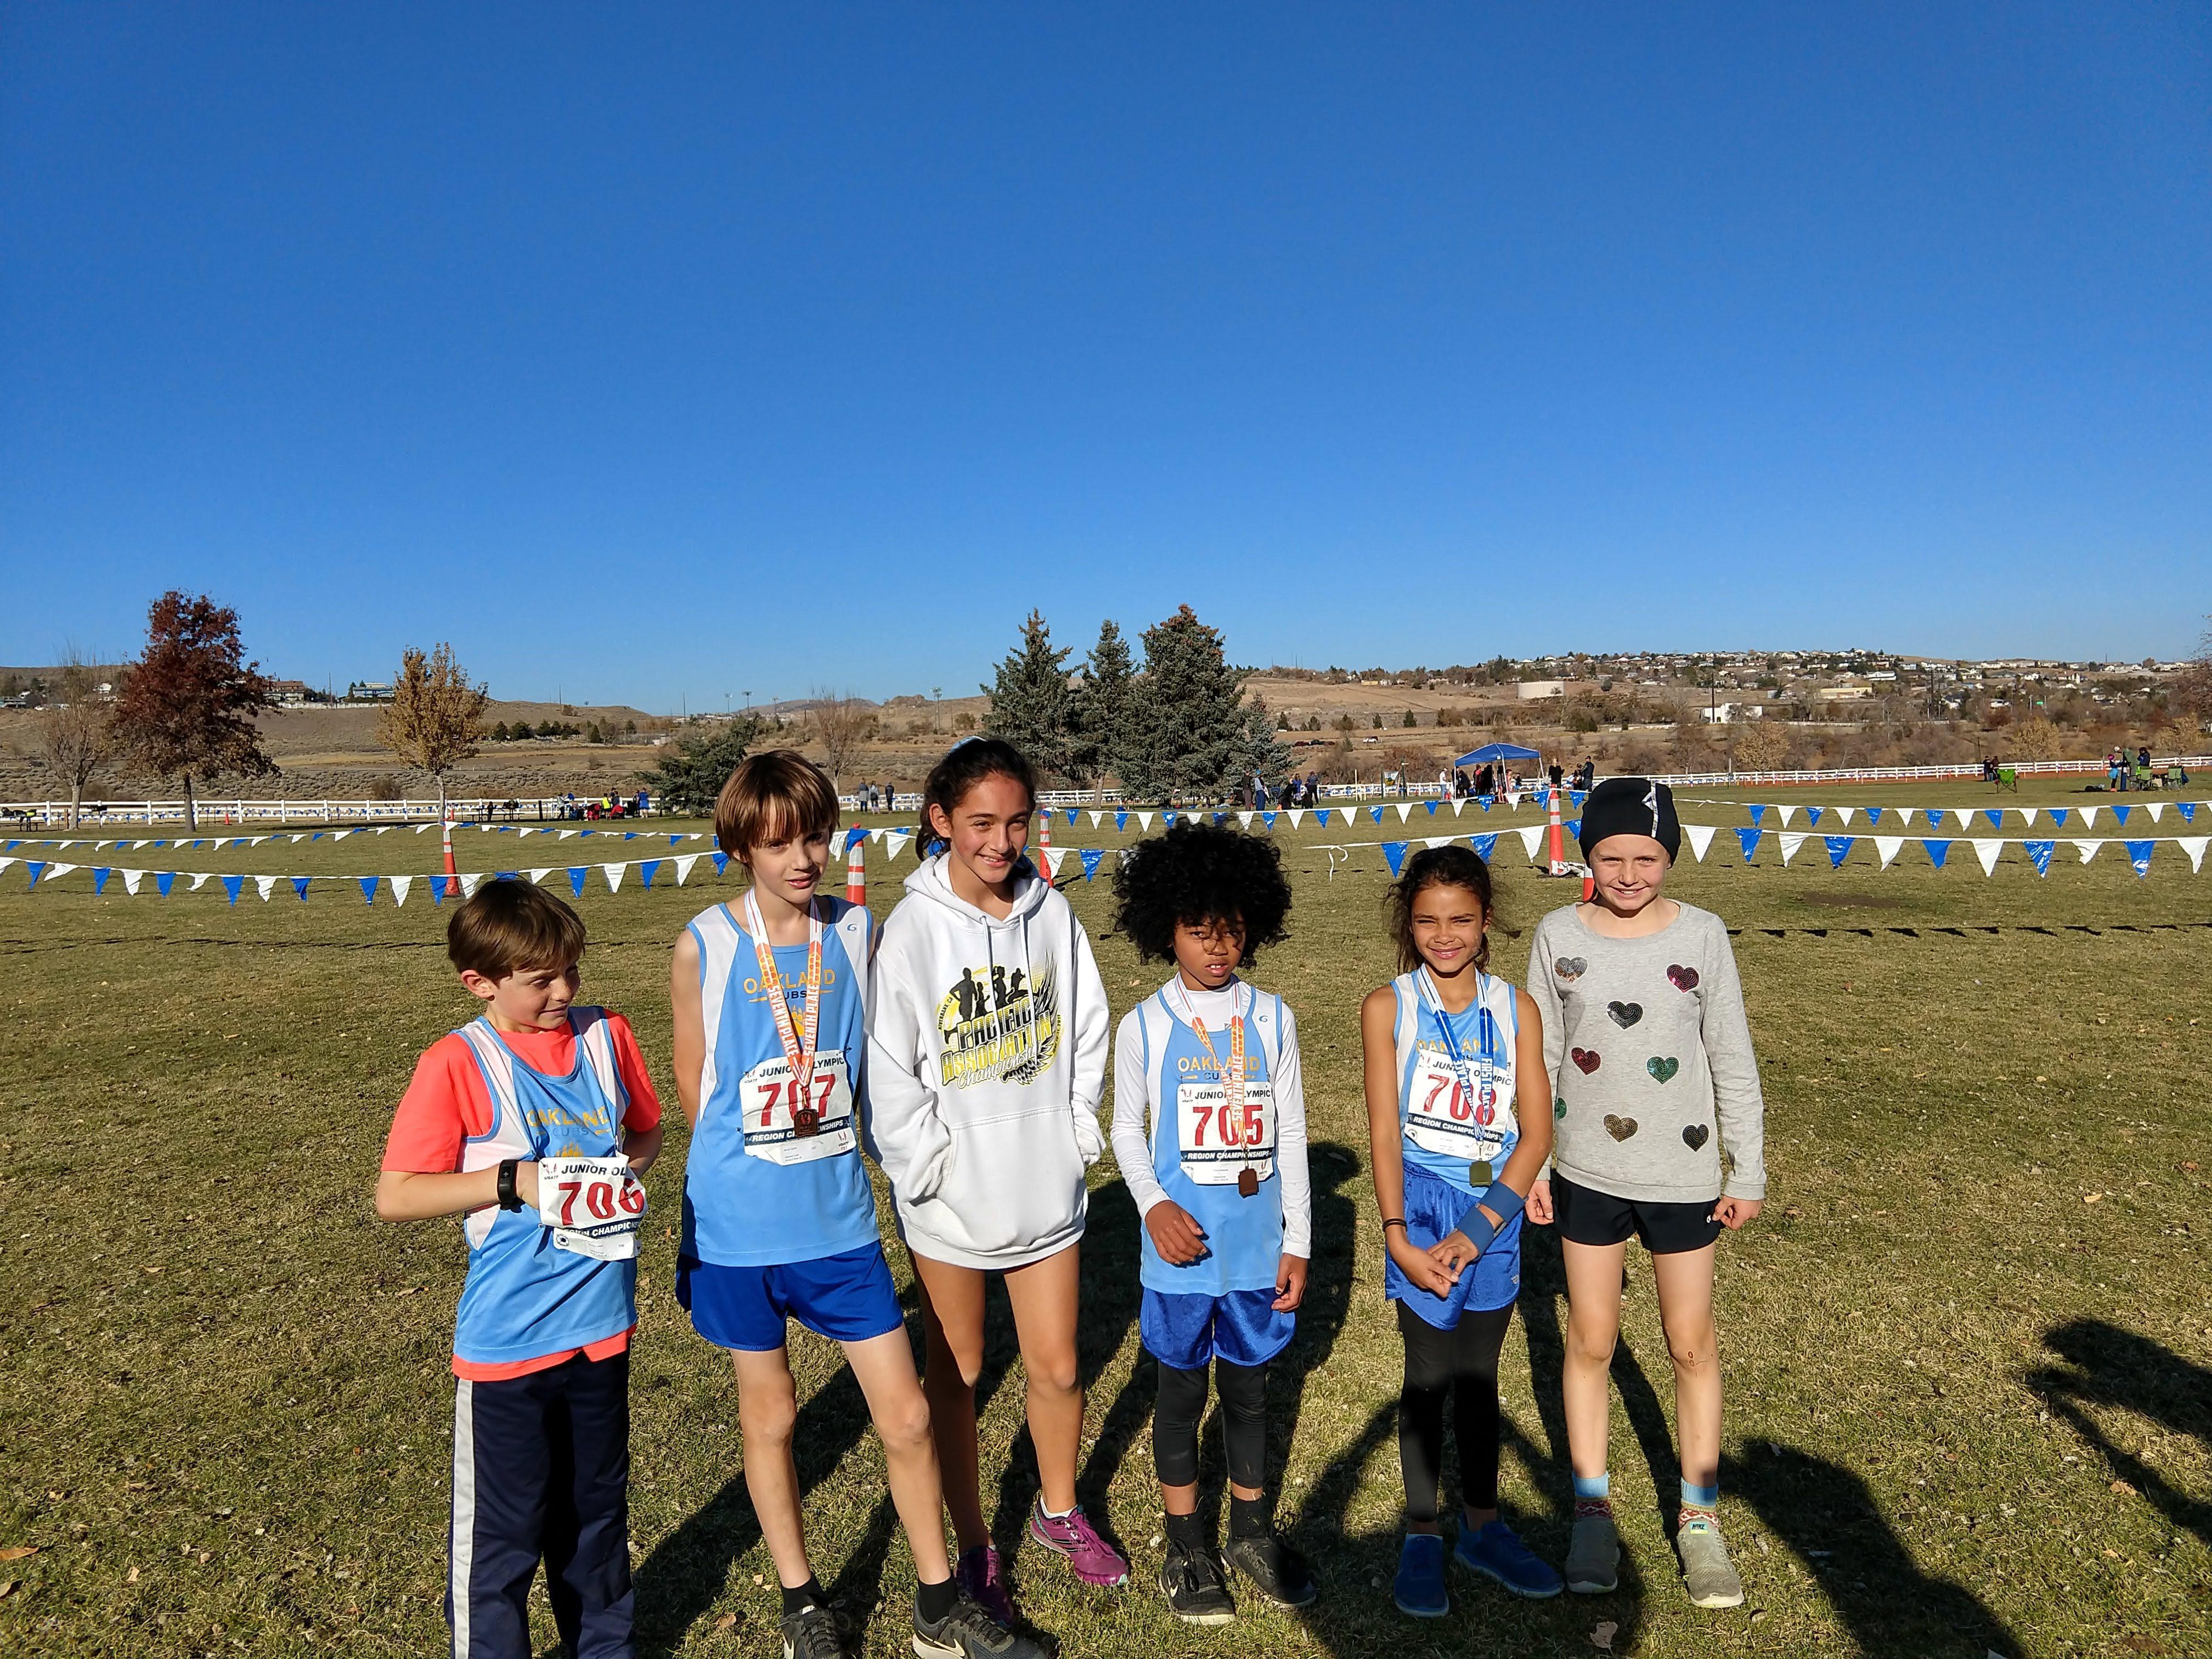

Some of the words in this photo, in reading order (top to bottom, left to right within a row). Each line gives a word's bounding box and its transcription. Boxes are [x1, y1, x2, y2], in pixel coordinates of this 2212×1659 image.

[784, 990, 807, 1000] UBS
[806, 984, 820, 1013] PLACE
[768, 985, 790, 1028] SEVENTH
[780, 1028, 800, 1057] PLACE
[804, 1014, 817, 1057] SEVENTH
[760, 1065, 792, 1077] JUNIO
[812, 1057, 845, 1069] LYMPIC
[1474, 1070, 1513, 1086] OMPIC
[1481, 1058, 1493, 1082] FIRST
[758, 1073, 836, 1127] 707
[1424, 1074, 1497, 1126] 708
[1193, 1104, 1263, 1146] 705
[1413, 1116, 1442, 1128] REGION
[752, 1132, 785, 1142] REGION
[1216, 1150, 1269, 1159] CHAMPINSHIPS
[561, 1164, 607, 1176] JUNIOR
[558, 1178, 645, 1226] 706
